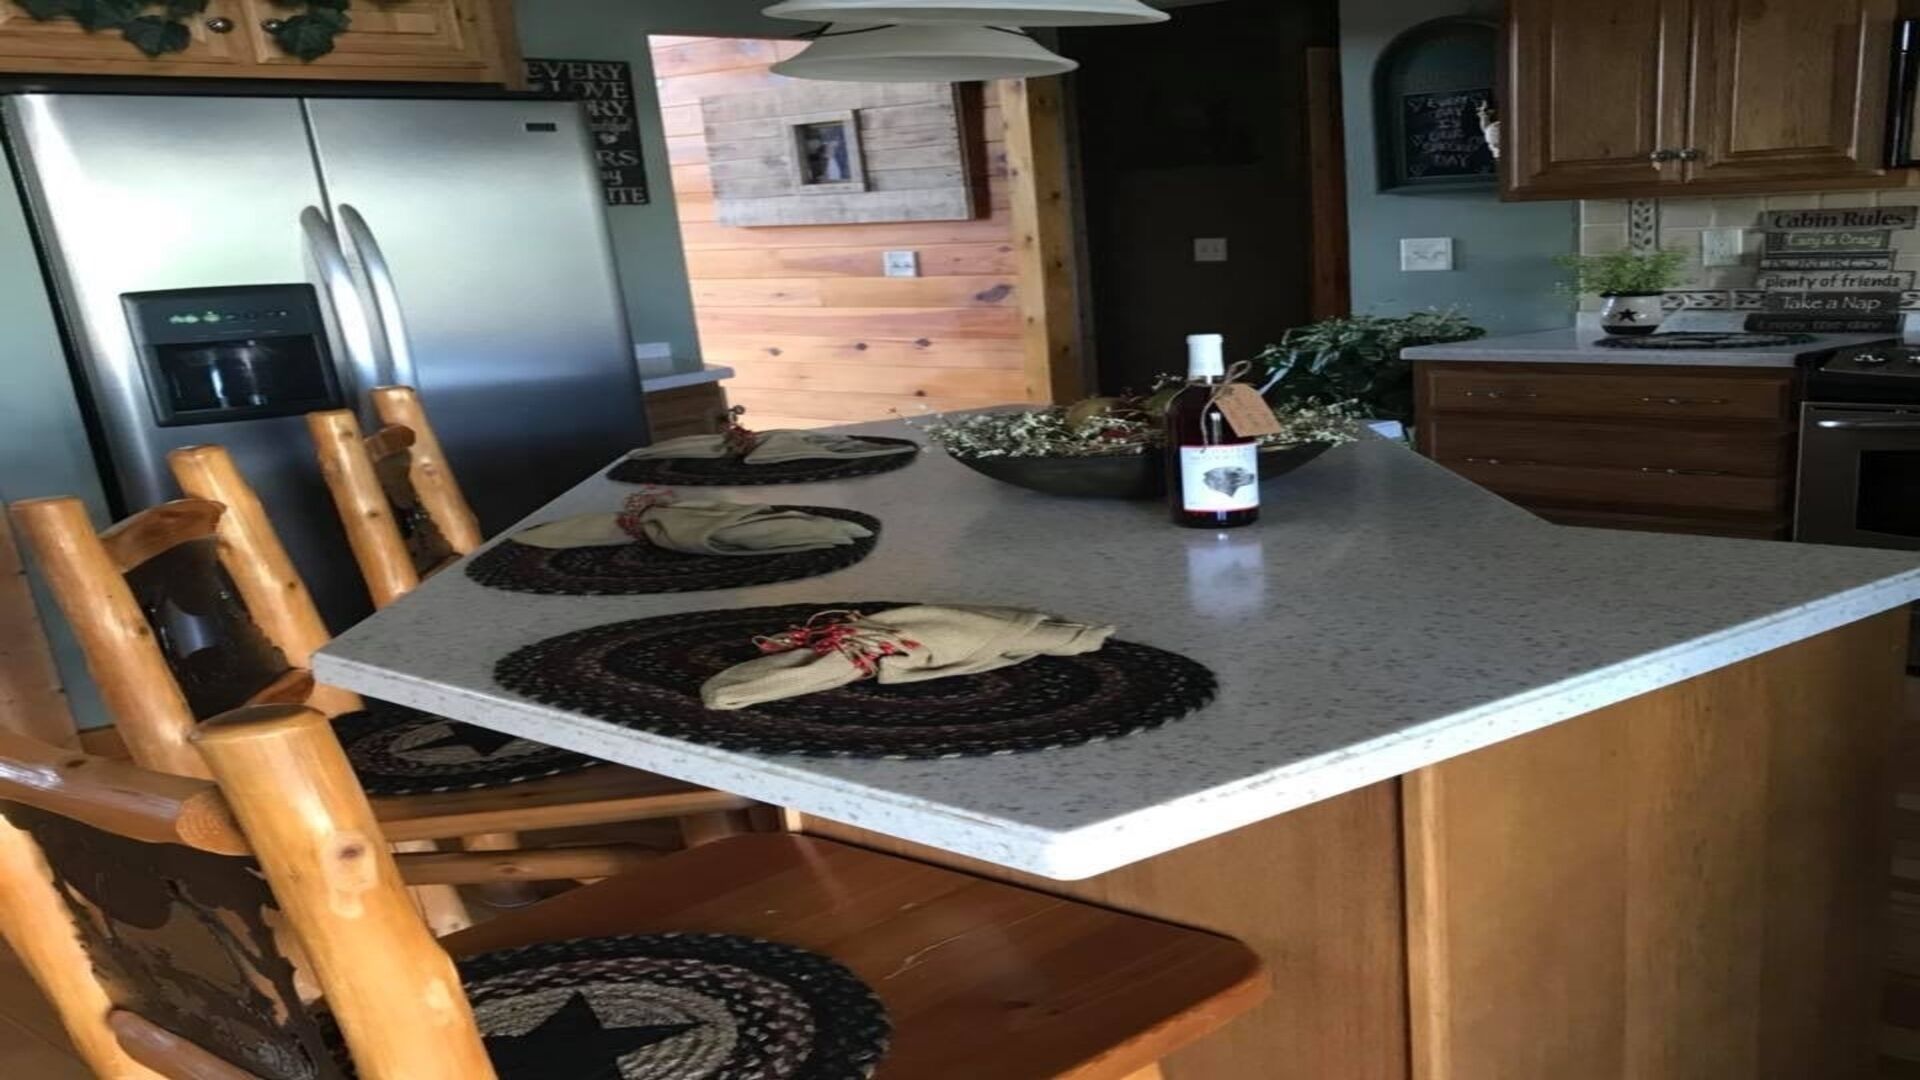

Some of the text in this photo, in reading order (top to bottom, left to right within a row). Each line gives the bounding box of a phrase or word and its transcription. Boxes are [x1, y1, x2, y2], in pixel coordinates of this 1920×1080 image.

[528, 61, 624, 80] EVERY
[1774, 209, 1906, 229] Cabin Rules
[1765, 274, 1901, 289] plenty of friends
[1782, 293, 1882, 313] Take a Nap
